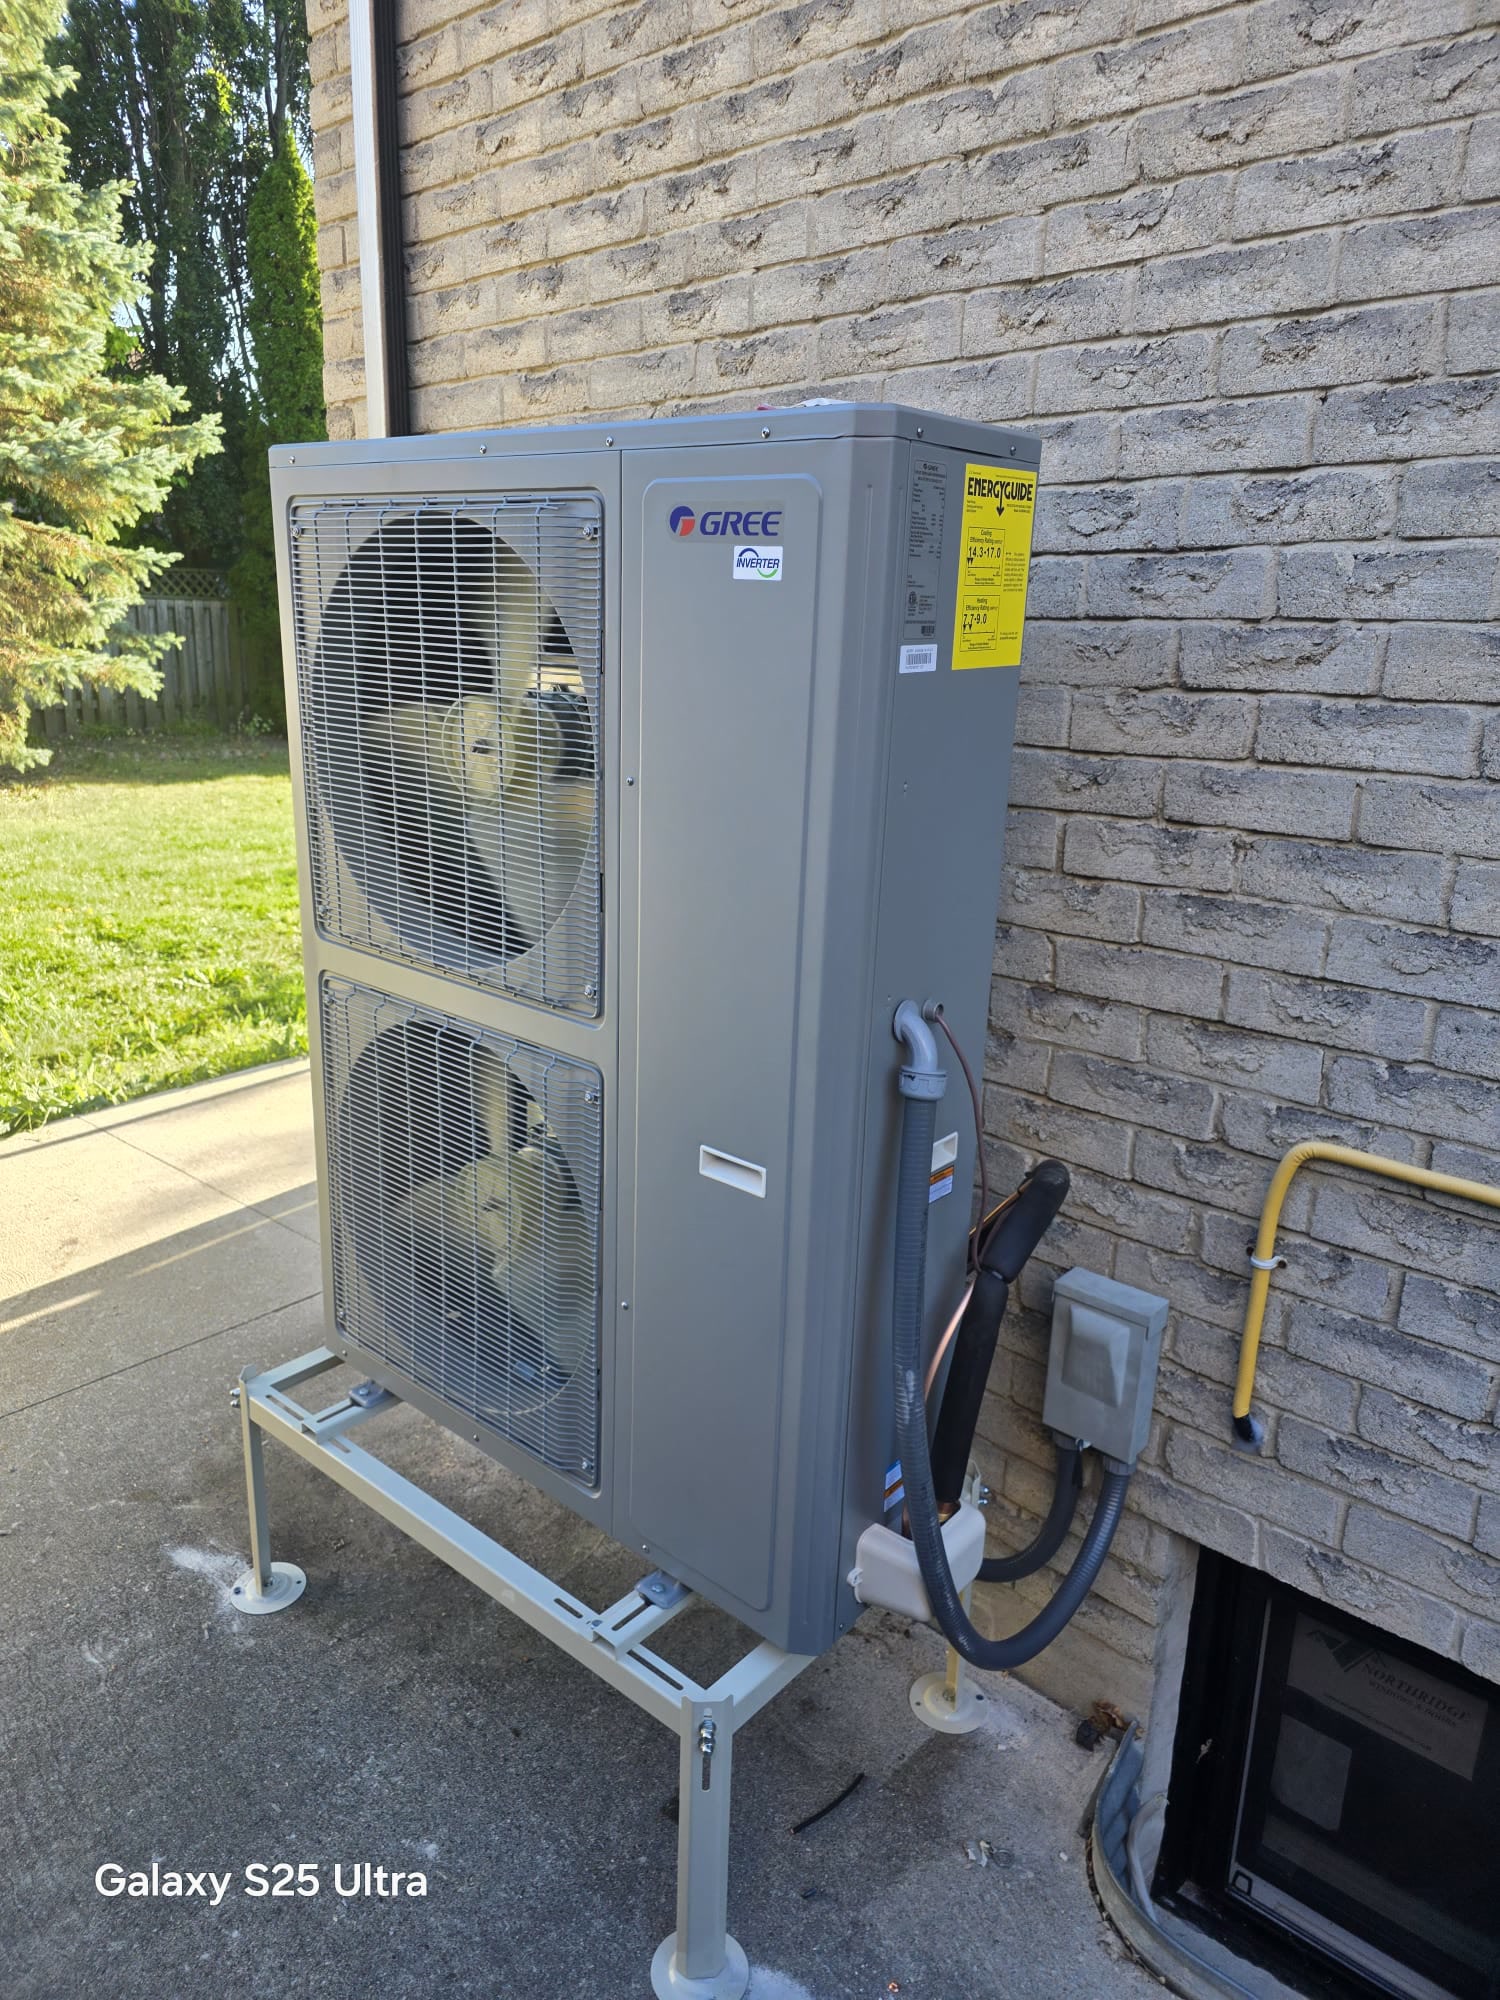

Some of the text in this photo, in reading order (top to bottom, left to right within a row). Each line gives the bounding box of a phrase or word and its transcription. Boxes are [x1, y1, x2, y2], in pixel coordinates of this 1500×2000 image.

[968, 477, 1033, 502] ENERGYGUIDE
[700, 511, 782, 536] GREE
[969, 546, 1001, 558] 14.3-17.0
[736, 558, 780, 569] INVERTER
[963, 613, 987, 625] 7.7-9.0
[1361, 1663, 1472, 1722] NORTHRIDGE
